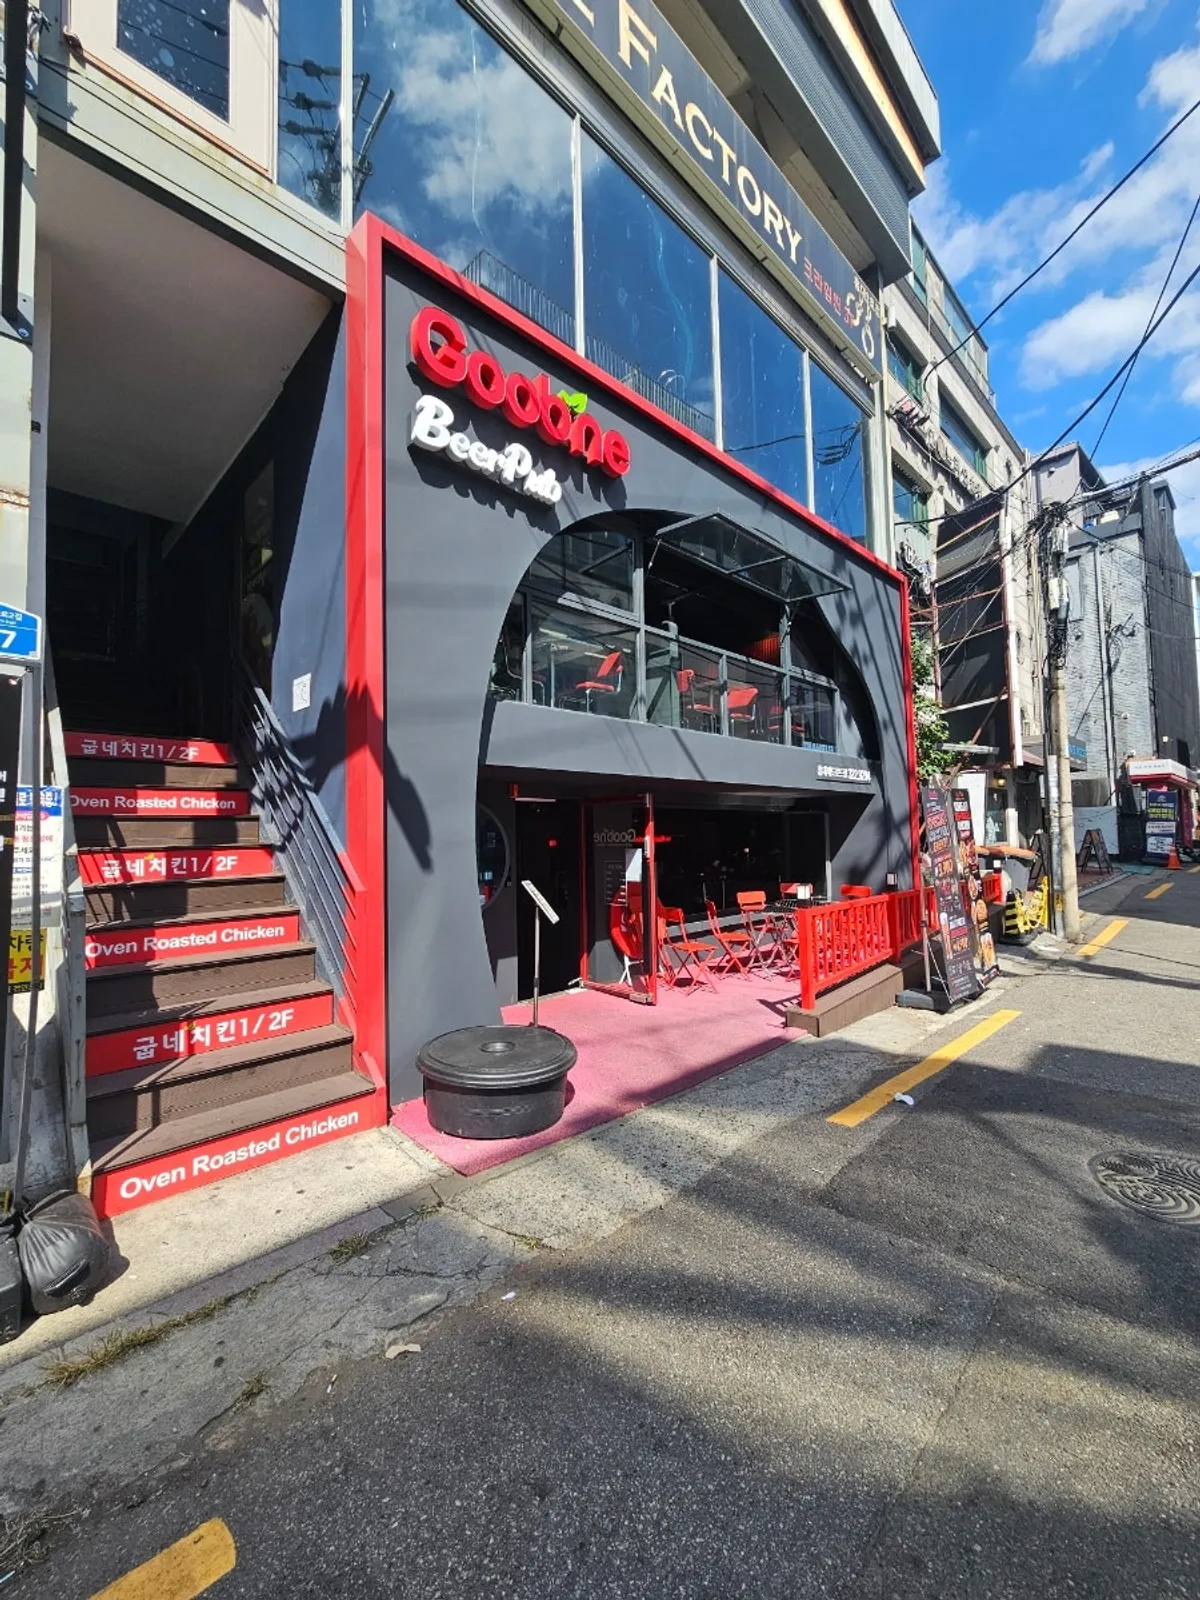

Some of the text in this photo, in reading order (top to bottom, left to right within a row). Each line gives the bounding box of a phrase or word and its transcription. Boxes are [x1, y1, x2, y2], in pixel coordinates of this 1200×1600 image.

[618, 0, 803, 265] FACTORY
[69, 794, 109, 809] Oven
[115, 794, 178, 809] Roasted
[180, 796, 236, 810] Chicken
[85, 924, 285, 957] Oven Roasted Chicken
[119, 1110, 359, 1199] Oven Roasted Chicken
